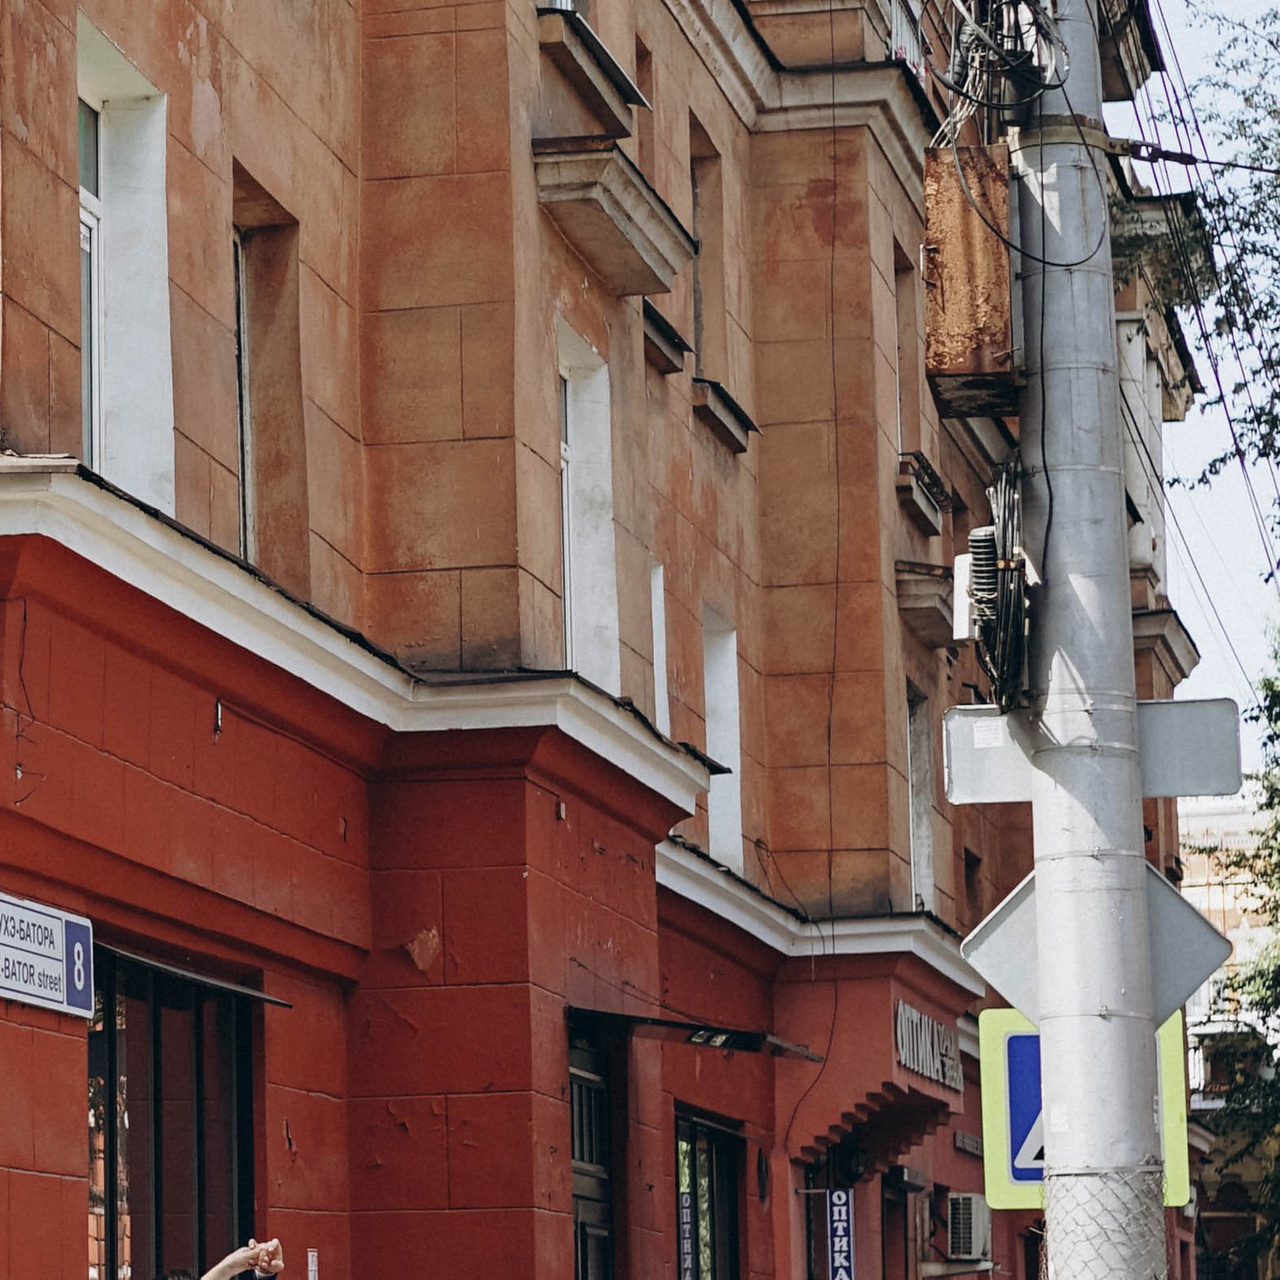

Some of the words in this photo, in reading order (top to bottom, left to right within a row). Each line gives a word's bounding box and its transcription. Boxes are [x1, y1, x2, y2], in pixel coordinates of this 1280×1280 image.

[37, 968, 62, 993] street
[73, 941, 85, 991] 8
[896, 999, 944, 1083] ОПТИКА
